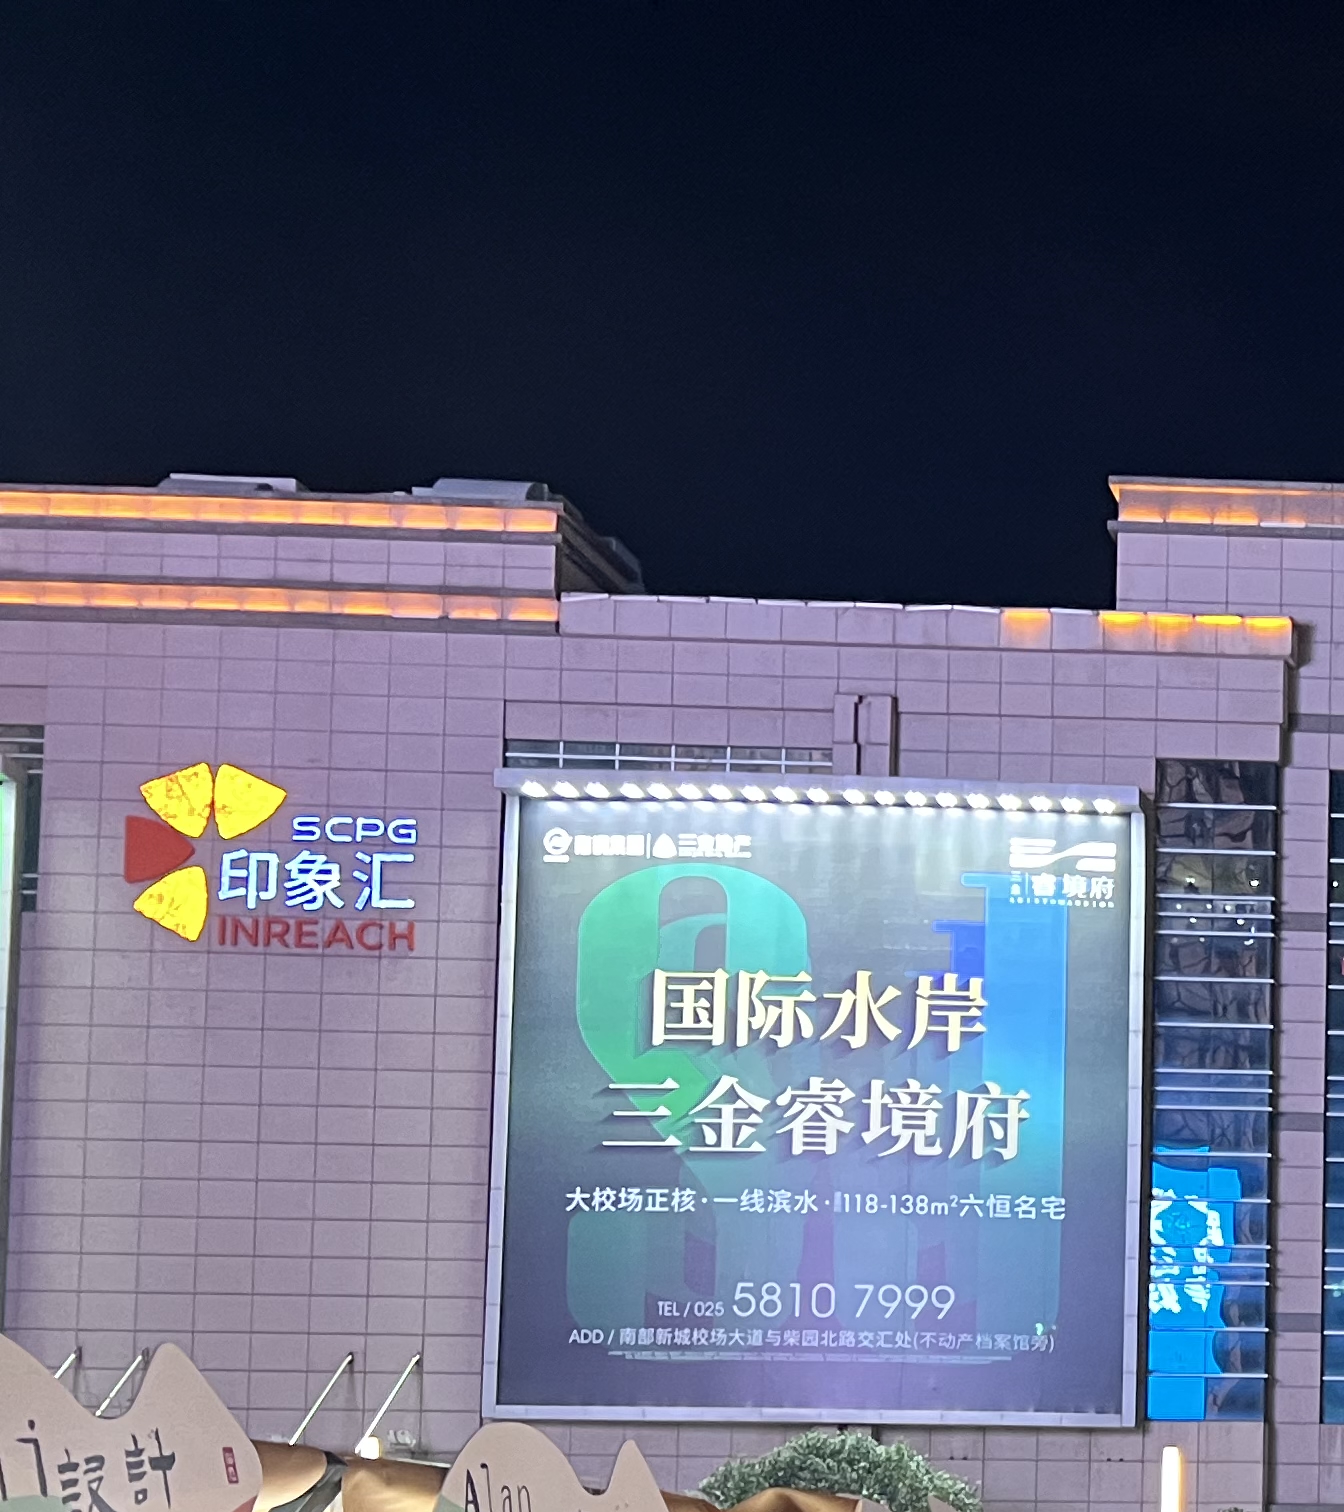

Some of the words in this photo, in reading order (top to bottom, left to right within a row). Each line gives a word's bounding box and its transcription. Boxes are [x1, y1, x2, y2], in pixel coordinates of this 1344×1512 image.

[292, 816, 417, 844] SCPG
[217, 849, 416, 911] 印象汇
[217, 916, 416, 952] INREACH
[650, 967, 988, 1052] 国际水岸
[600, 1074, 1031, 1161] 三金睿境府
[732, 1281, 836, 1318] 5810
[854, 1283, 956, 1320] 7999
